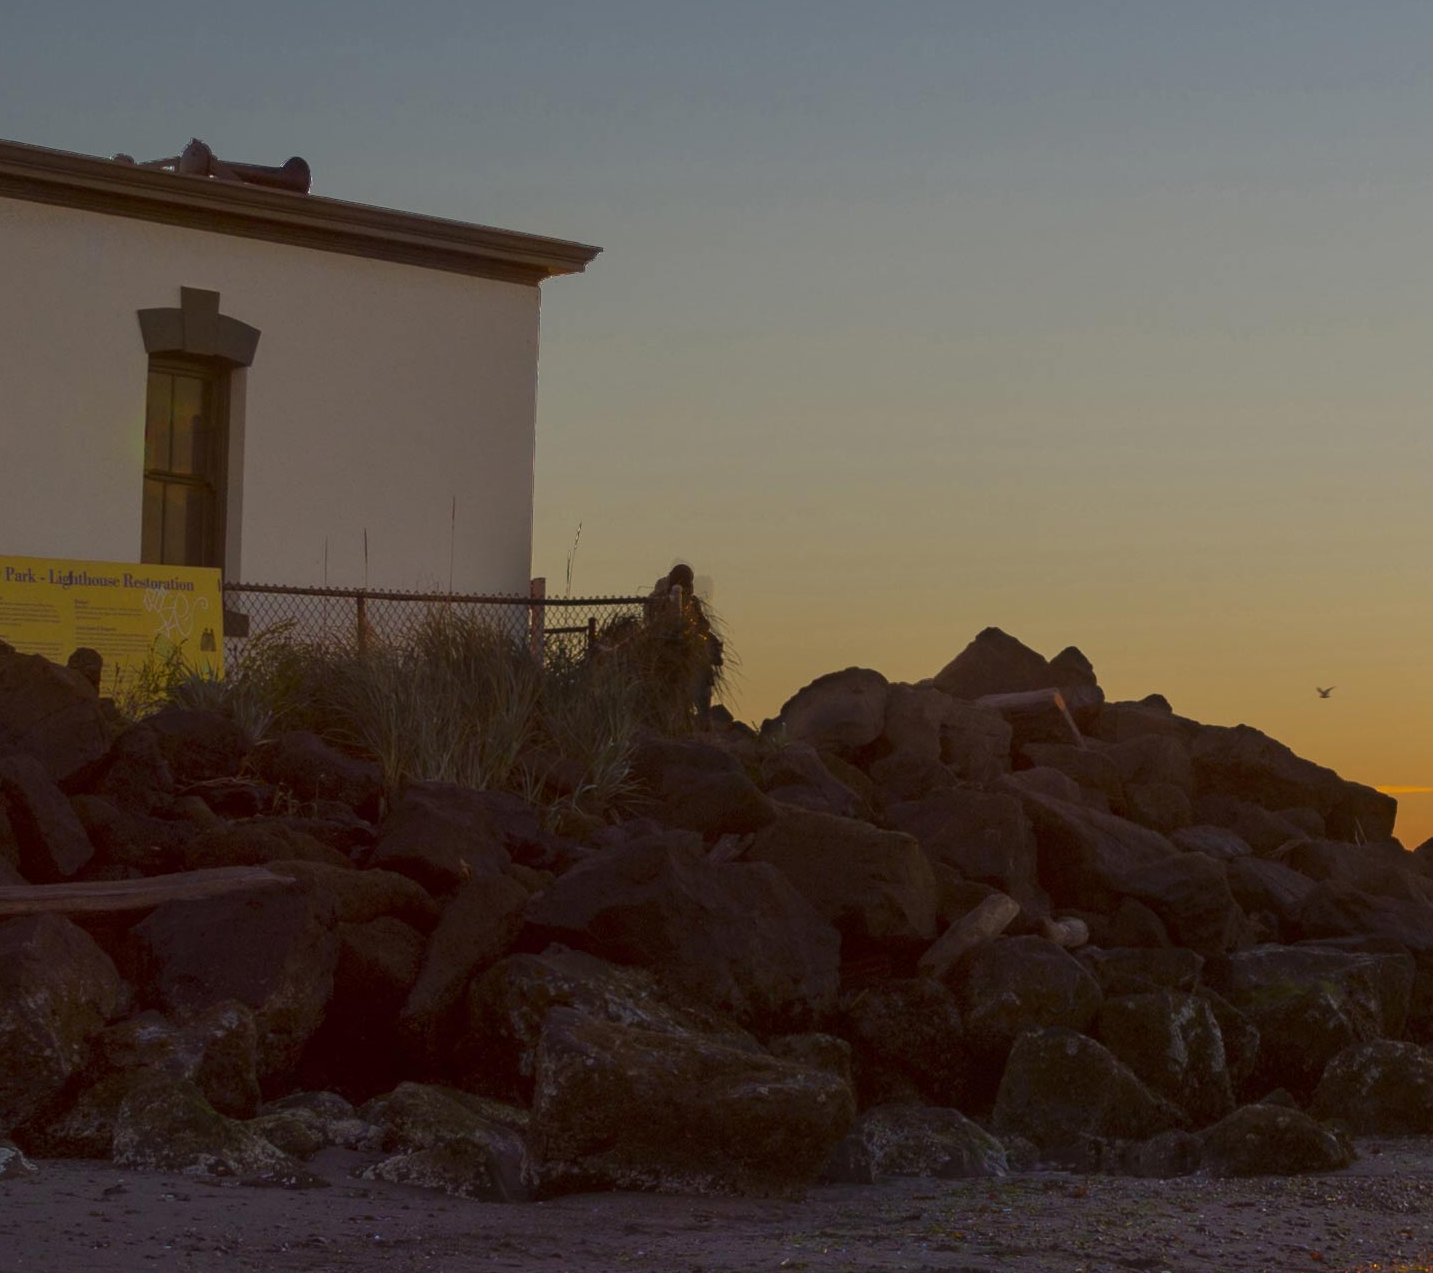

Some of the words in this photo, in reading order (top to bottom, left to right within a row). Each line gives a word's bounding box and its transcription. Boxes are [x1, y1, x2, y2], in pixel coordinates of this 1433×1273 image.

[5, 566, 36, 583] Park
[49, 568, 120, 589] Lighthouse
[123, 572, 194, 591] Restoration
